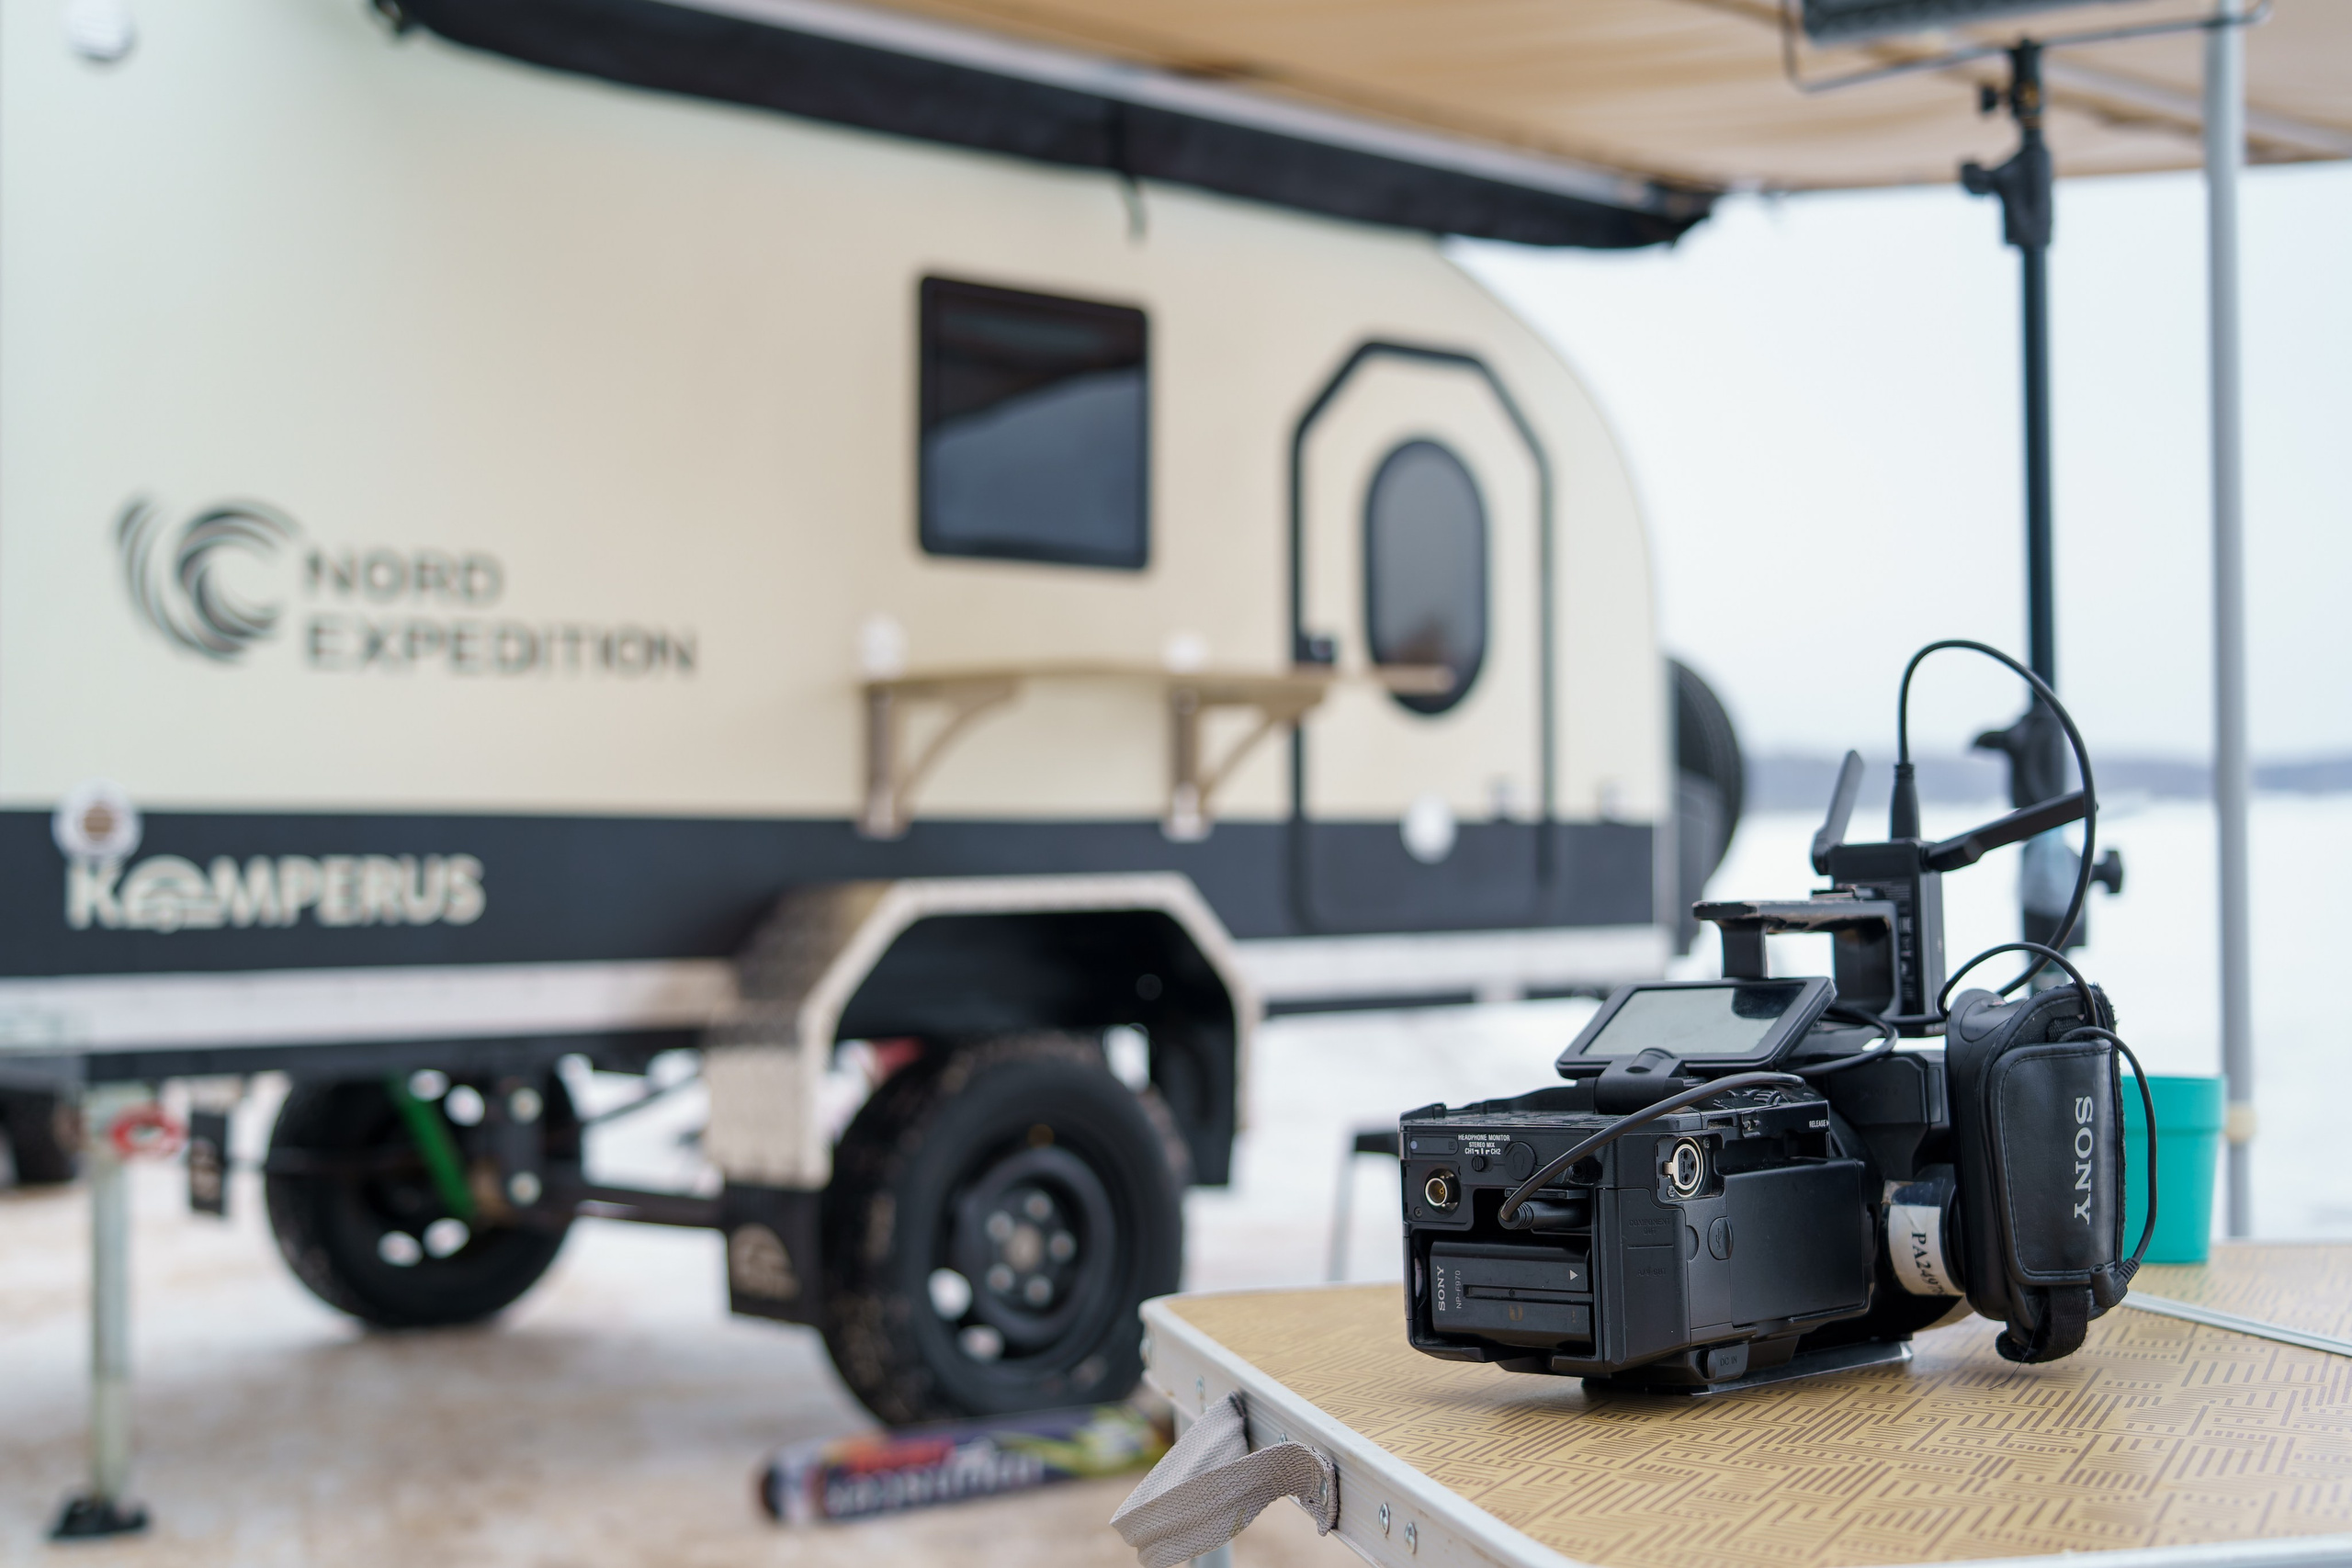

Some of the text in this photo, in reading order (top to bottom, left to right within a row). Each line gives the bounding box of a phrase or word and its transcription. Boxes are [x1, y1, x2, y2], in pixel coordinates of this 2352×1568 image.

[303, 549, 503, 605] NORD
[304, 614, 698, 677] EXPEDITION
[1809, 1120, 1826, 1128] RELEASE
[2074, 1096, 2093, 1225] SONY
[1629, 1217, 1670, 1227] COMPONENT
[1437, 1266, 1446, 1311] SONY
[1454, 1269, 1463, 1309] NP-F970
[1720, 1355, 1737, 1367] DC IN
